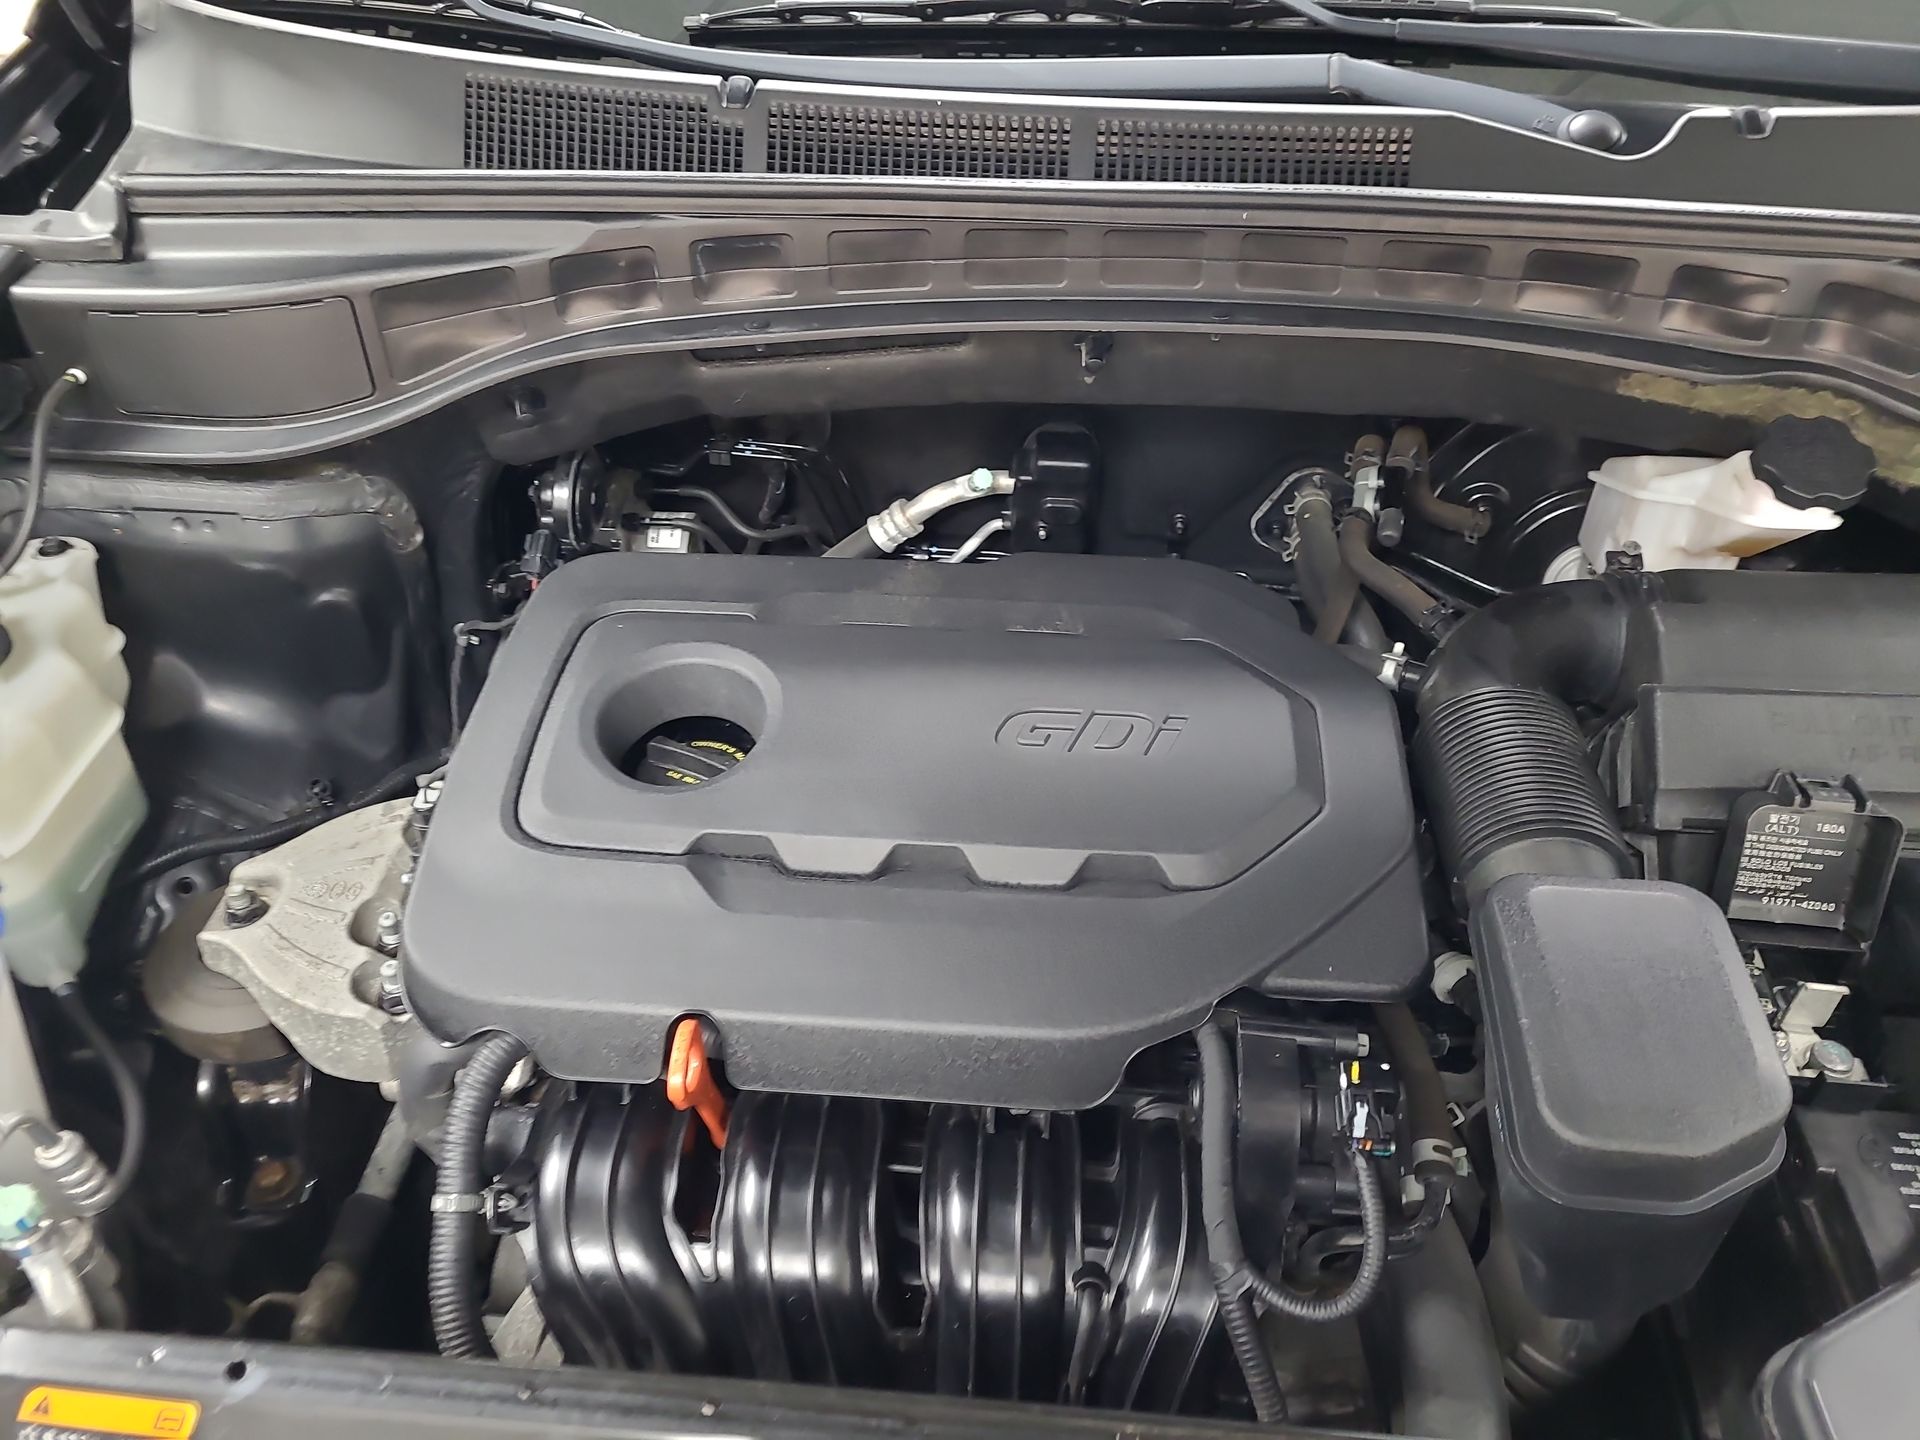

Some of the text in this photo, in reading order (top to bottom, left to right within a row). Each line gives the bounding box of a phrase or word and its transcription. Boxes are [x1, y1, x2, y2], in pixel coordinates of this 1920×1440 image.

[995, 707, 1189, 756] GDi
[1765, 824, 1800, 836] (ALT)
[1816, 823, 1846, 834] 180A
[1761, 896, 1836, 912] 91971-4Z060
